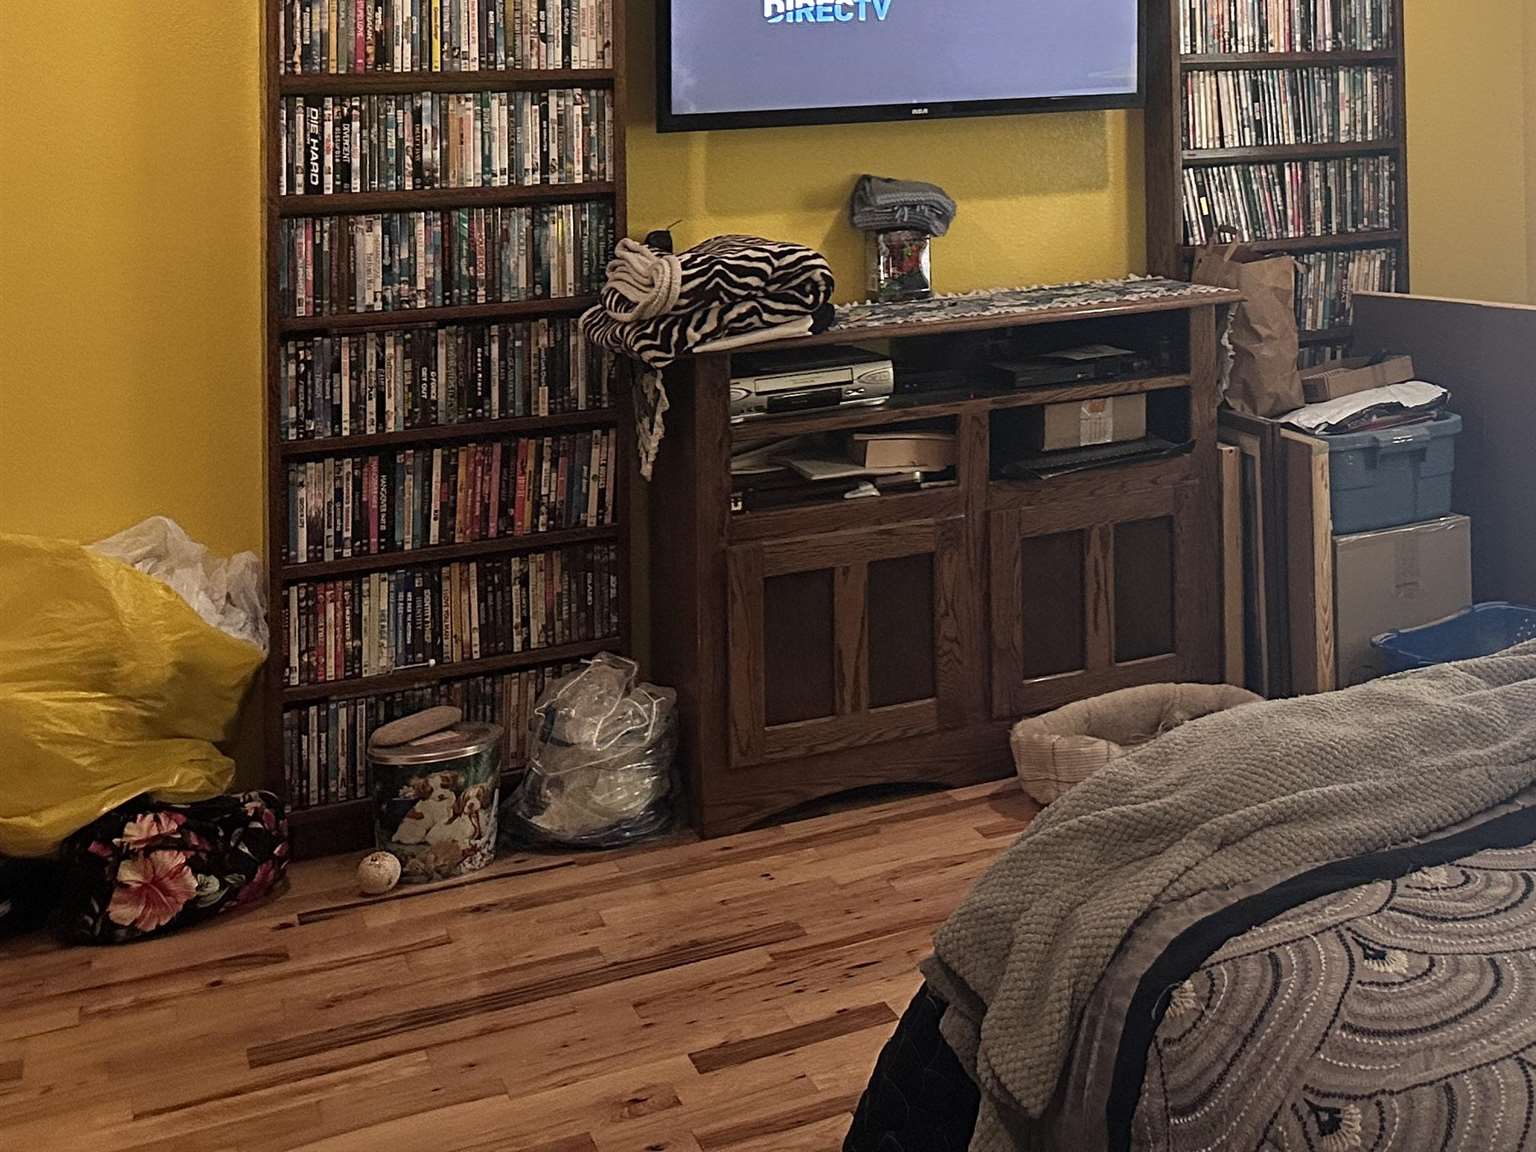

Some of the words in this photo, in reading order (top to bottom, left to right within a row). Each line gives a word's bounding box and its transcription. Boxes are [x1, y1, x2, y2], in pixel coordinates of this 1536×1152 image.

[310, 107, 319, 134] DIE
[310, 138, 319, 185] HARD
[342, 123, 350, 163] DIVERGENT
